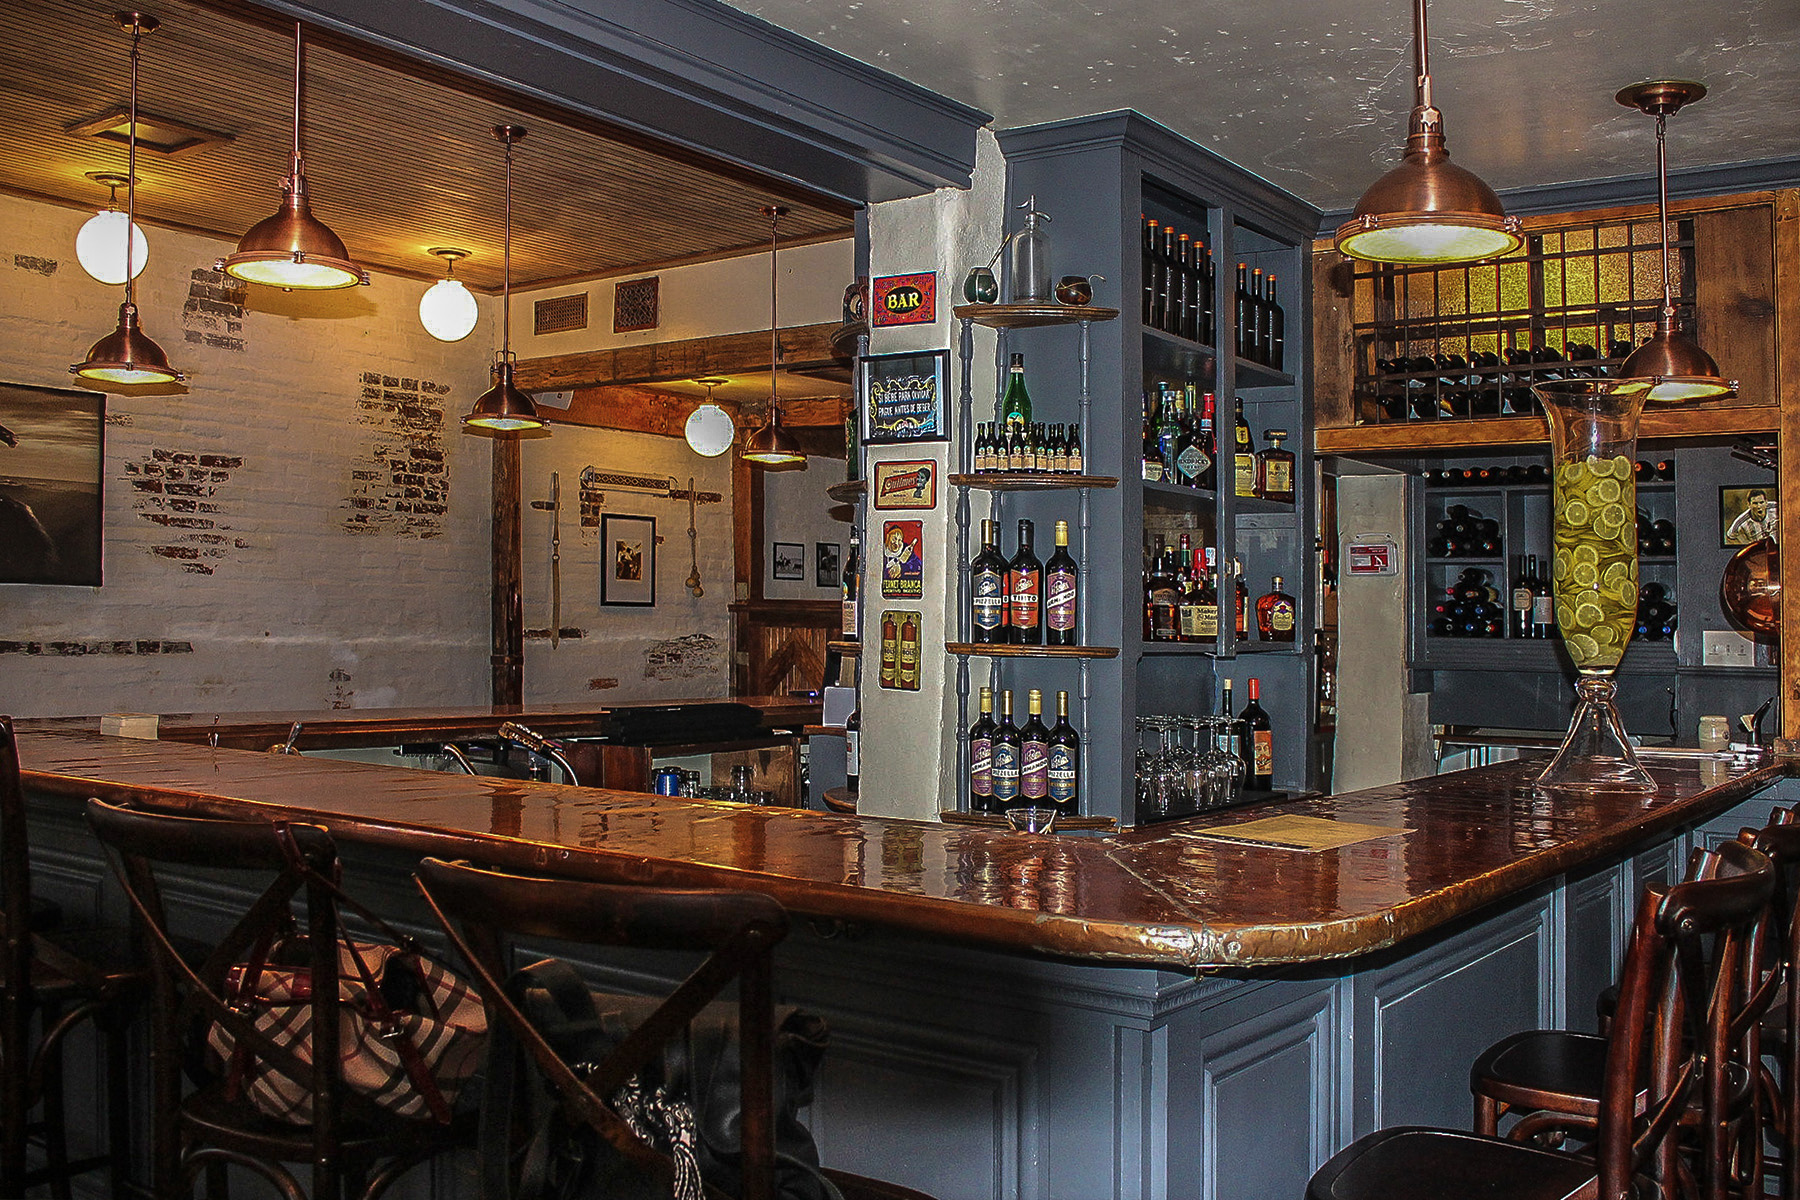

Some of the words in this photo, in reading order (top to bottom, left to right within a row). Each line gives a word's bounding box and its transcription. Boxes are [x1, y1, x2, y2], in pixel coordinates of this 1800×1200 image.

[887, 291, 920, 309] BAR
[884, 392, 898, 403] BEBE
[898, 390, 912, 401] PARA
[878, 406, 893, 417] PAGUE
[894, 404, 910, 415] ANTES
[910, 403, 916, 414] DE
[916, 402, 931, 413] BEBER
[884, 477, 917, 490] Quilmes
